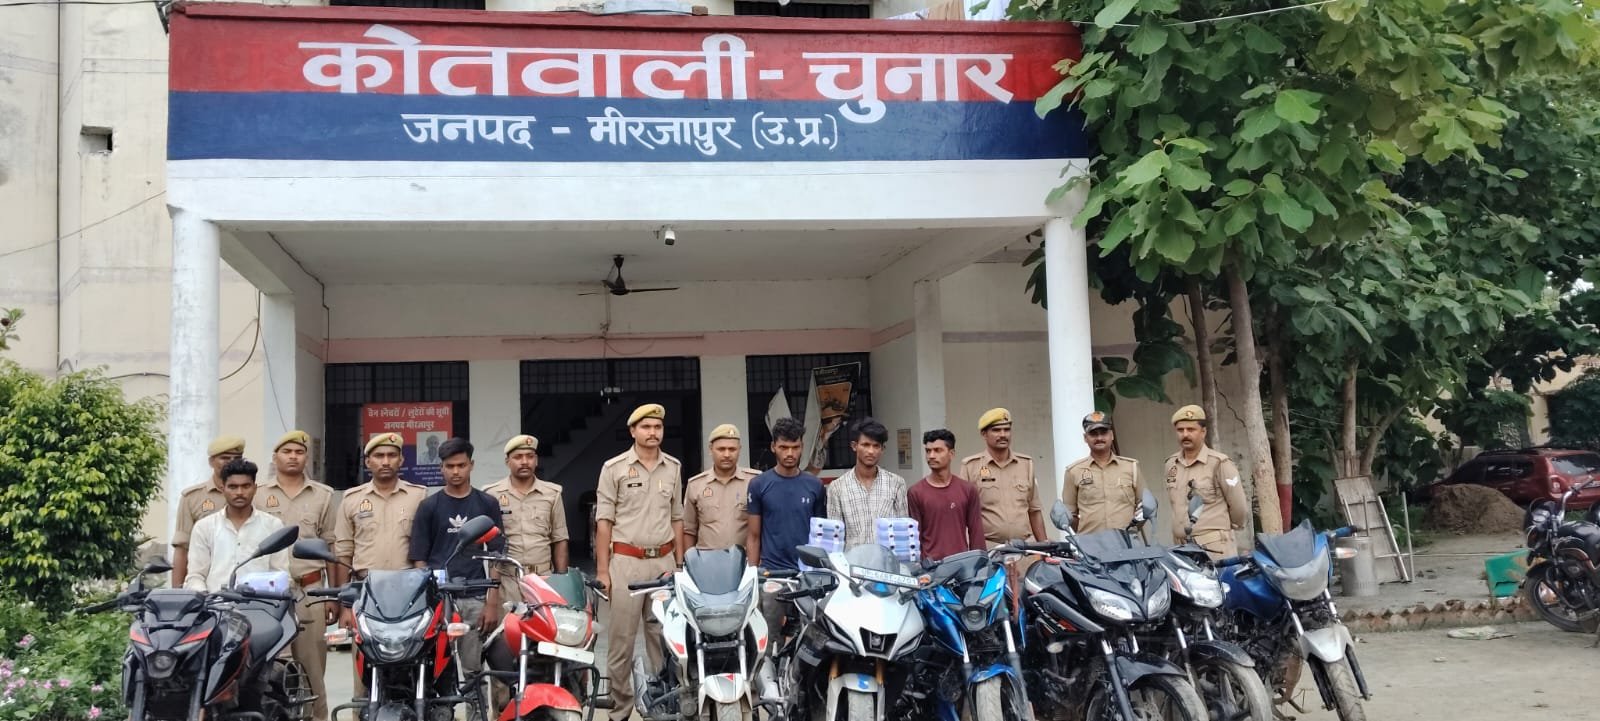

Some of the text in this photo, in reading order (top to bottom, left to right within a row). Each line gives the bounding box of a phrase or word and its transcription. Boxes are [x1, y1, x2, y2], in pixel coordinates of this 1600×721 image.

[802, 51, 1014, 125] चुनार
[401, 113, 537, 150] जनपद
[586, 107, 742, 156] मीरजापुर
